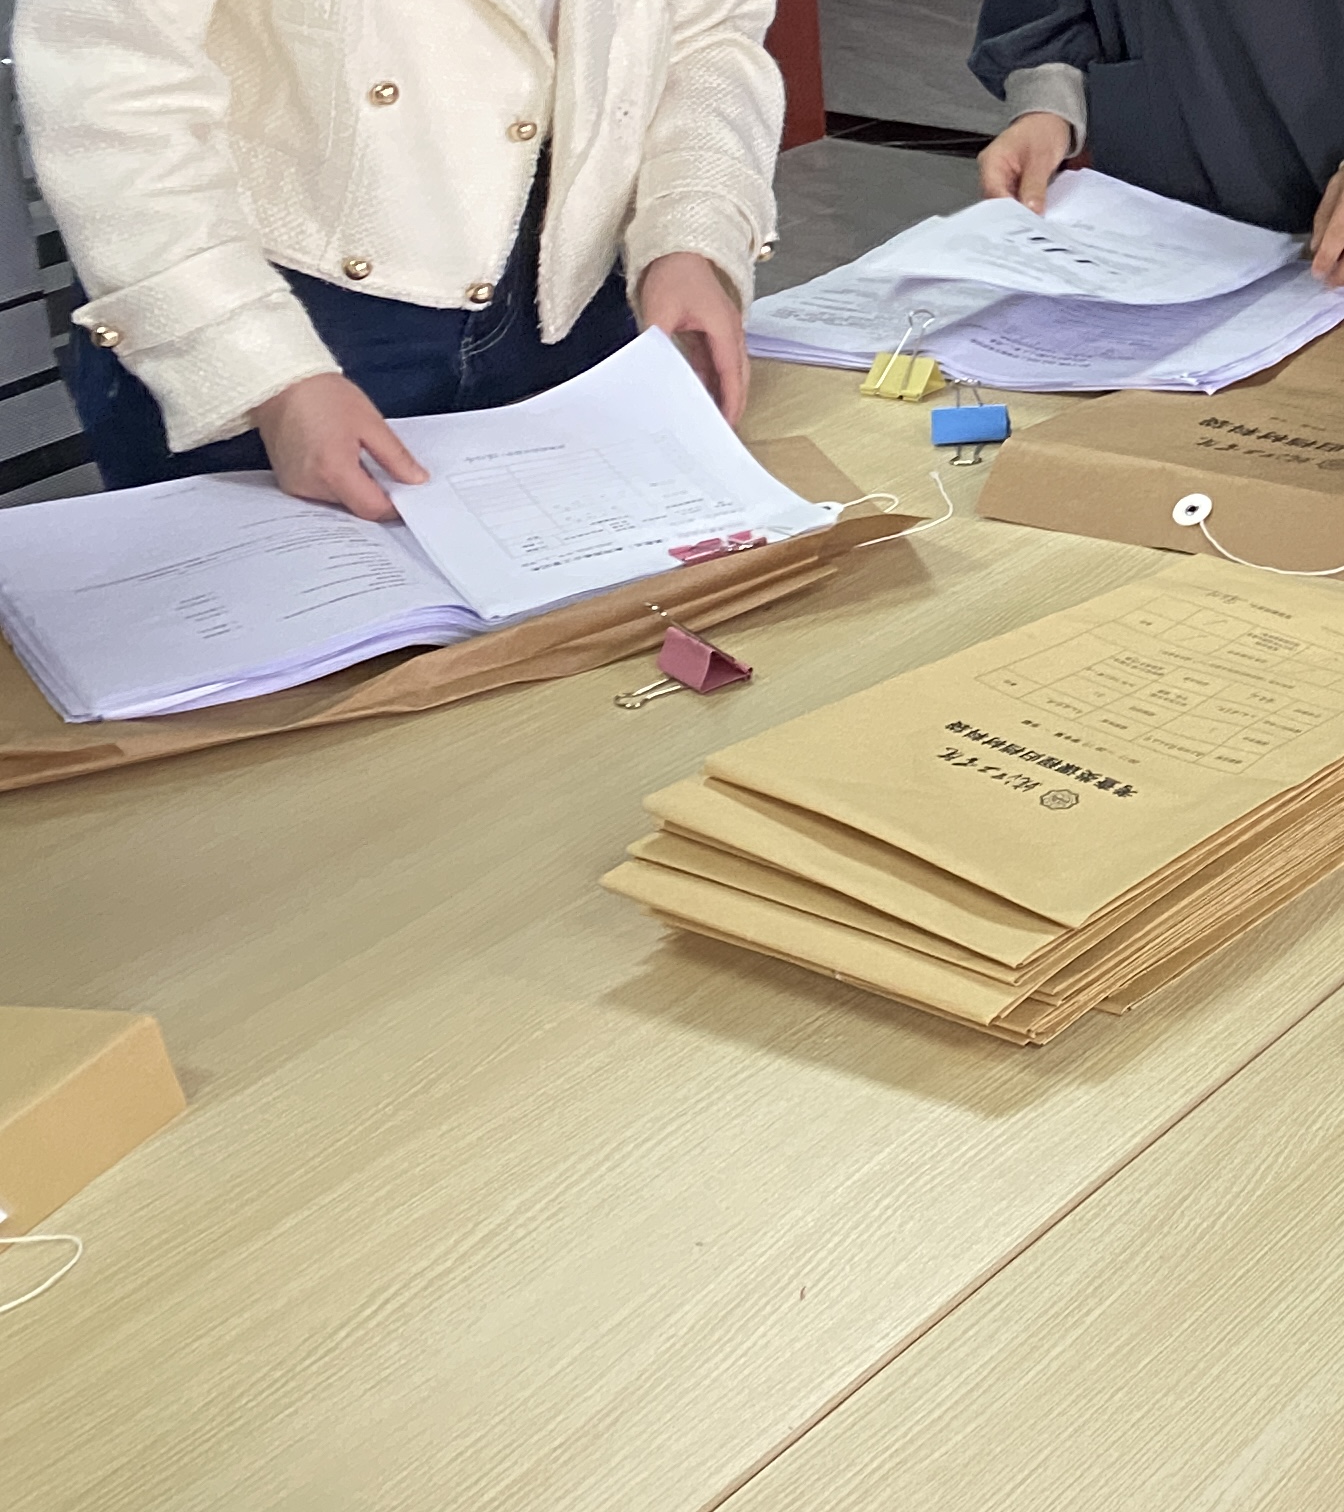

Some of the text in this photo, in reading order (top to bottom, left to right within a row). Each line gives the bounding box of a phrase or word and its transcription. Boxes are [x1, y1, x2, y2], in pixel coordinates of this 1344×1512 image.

[943, 720, 1136, 798] 考查类课程归档材料袋
